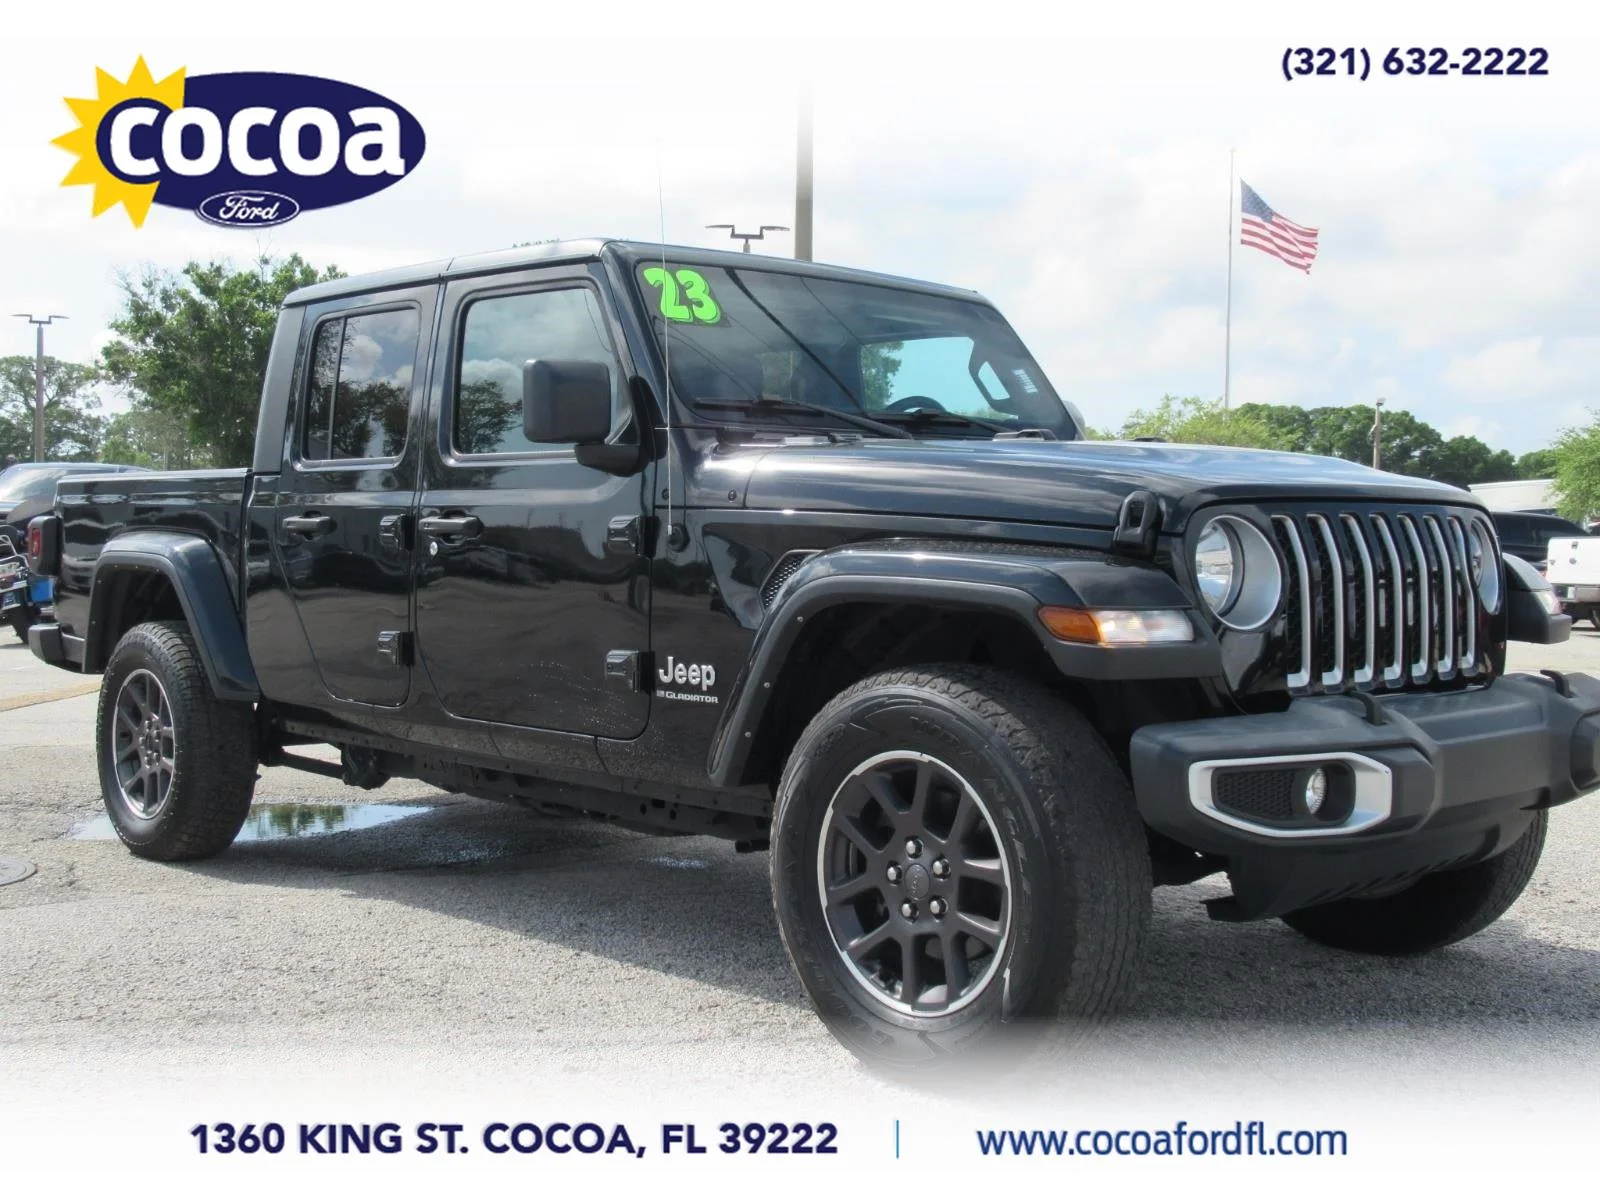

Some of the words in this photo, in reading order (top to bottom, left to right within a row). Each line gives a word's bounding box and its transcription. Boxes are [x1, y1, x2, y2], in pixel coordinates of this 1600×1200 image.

[643, 267, 721, 324] 23
[658, 655, 716, 691] Jeep
[665, 690, 719, 704] GLADIATOR
